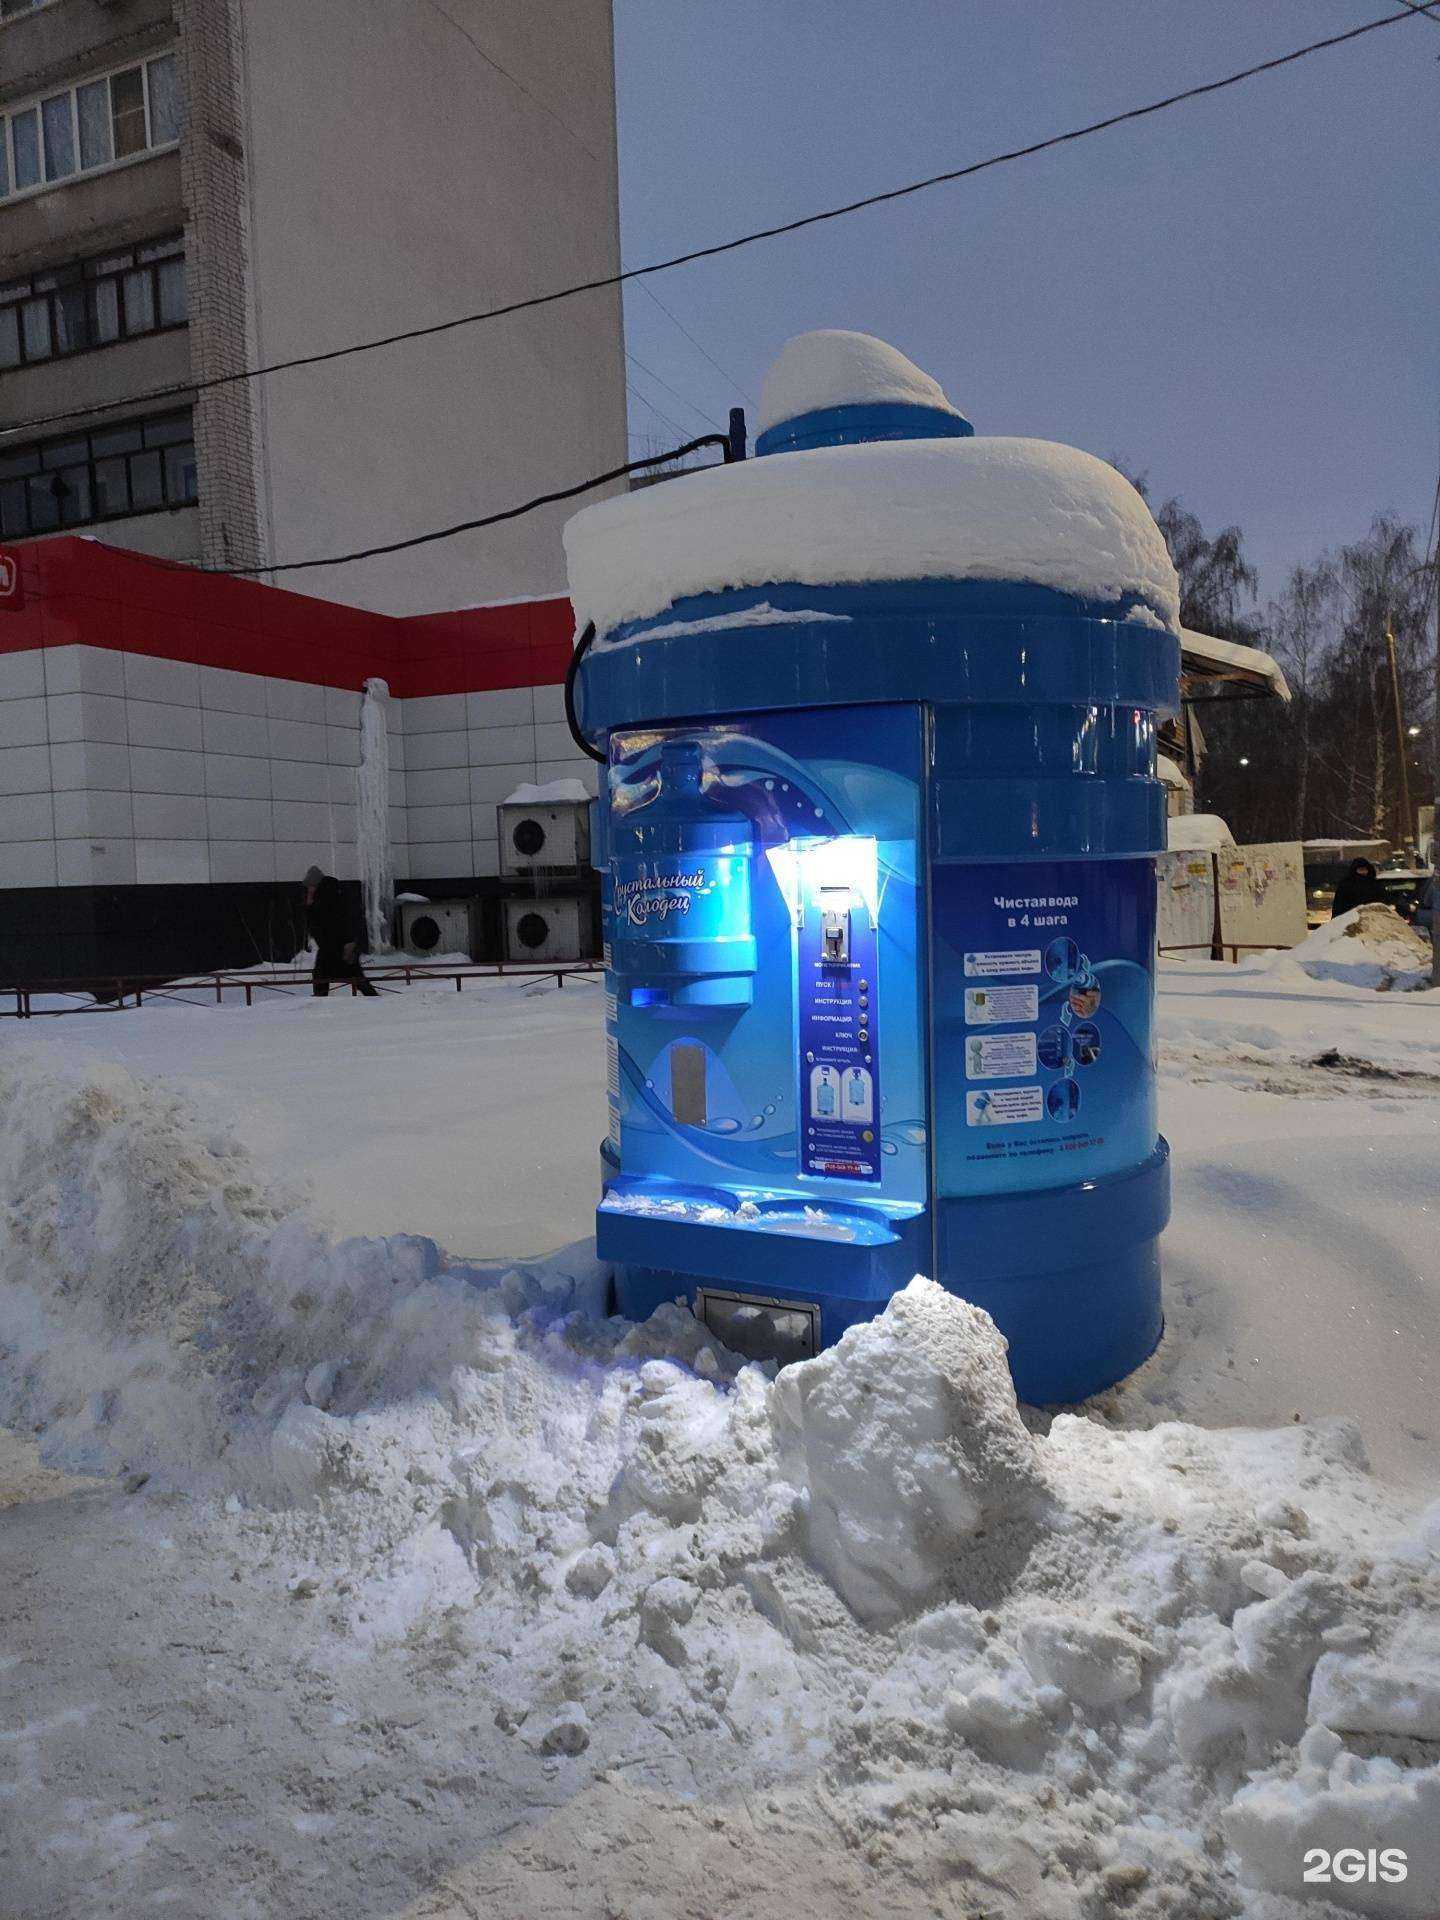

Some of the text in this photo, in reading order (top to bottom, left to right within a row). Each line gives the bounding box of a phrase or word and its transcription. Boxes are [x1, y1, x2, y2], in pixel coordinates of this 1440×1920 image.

[993, 895, 1079, 910] Чистая вода
[627, 893, 690, 926] Колодец
[1007, 914, 1068, 927] в 4 шага
[814, 997, 853, 1005] ИНСТРУКЦИЯ
[811, 1015, 853, 1023] ИНФОРМАЦИЯ
